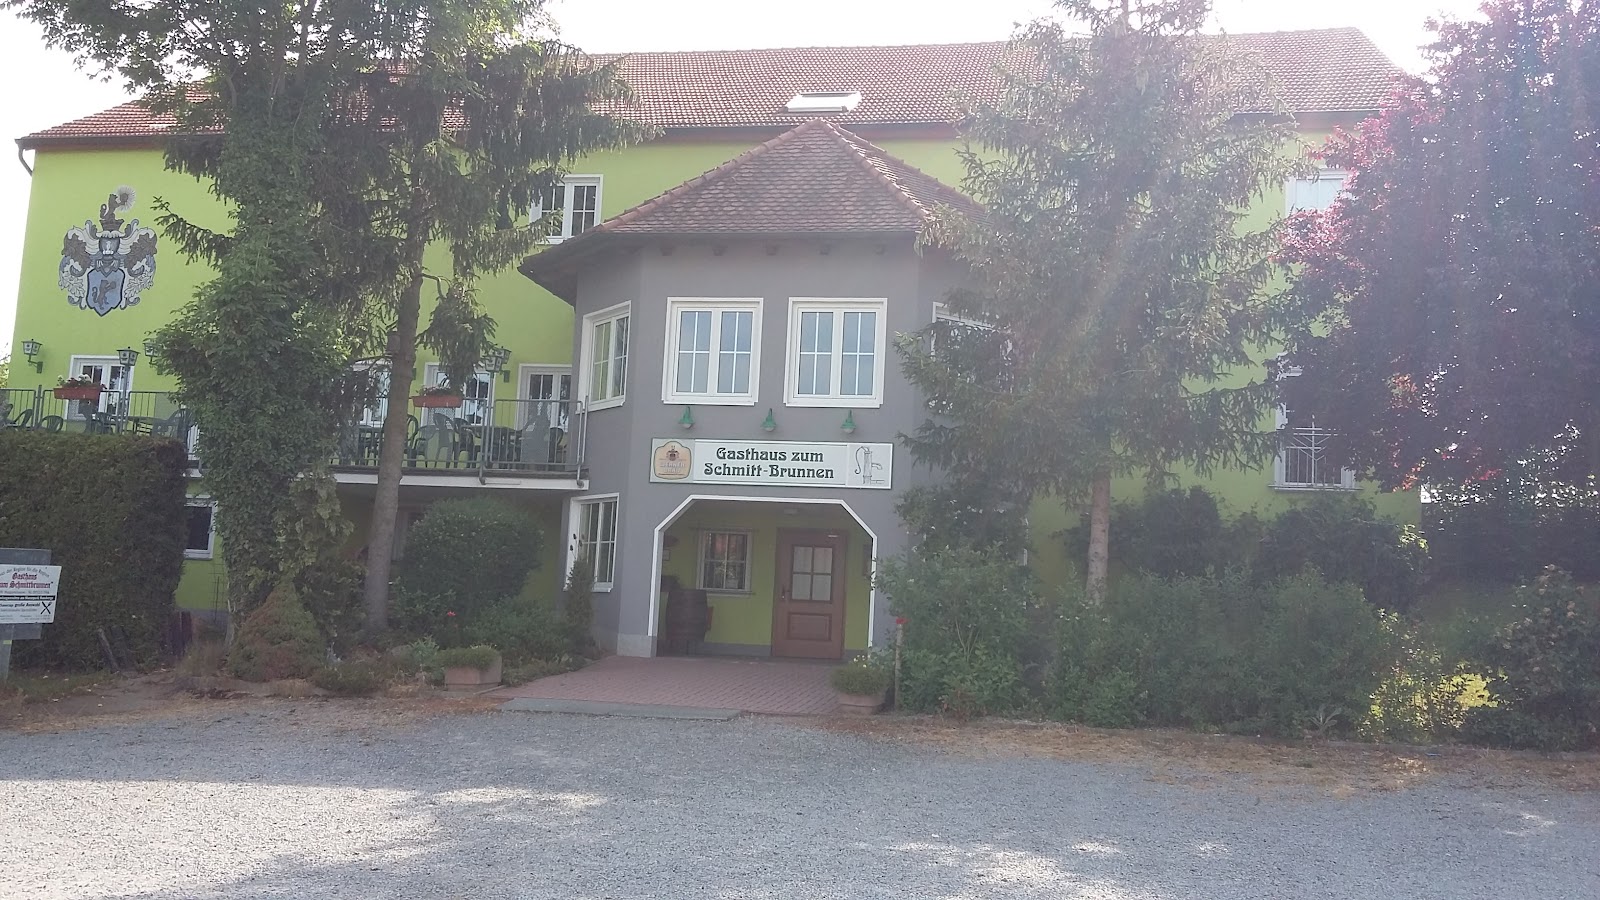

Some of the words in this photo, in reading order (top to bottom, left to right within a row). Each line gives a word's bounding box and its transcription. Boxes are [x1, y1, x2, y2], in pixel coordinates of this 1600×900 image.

[716, 447, 787, 461] Gasthaus
[790, 451, 824, 463] zum
[703, 463, 835, 479] Schmitt-Brunnen
